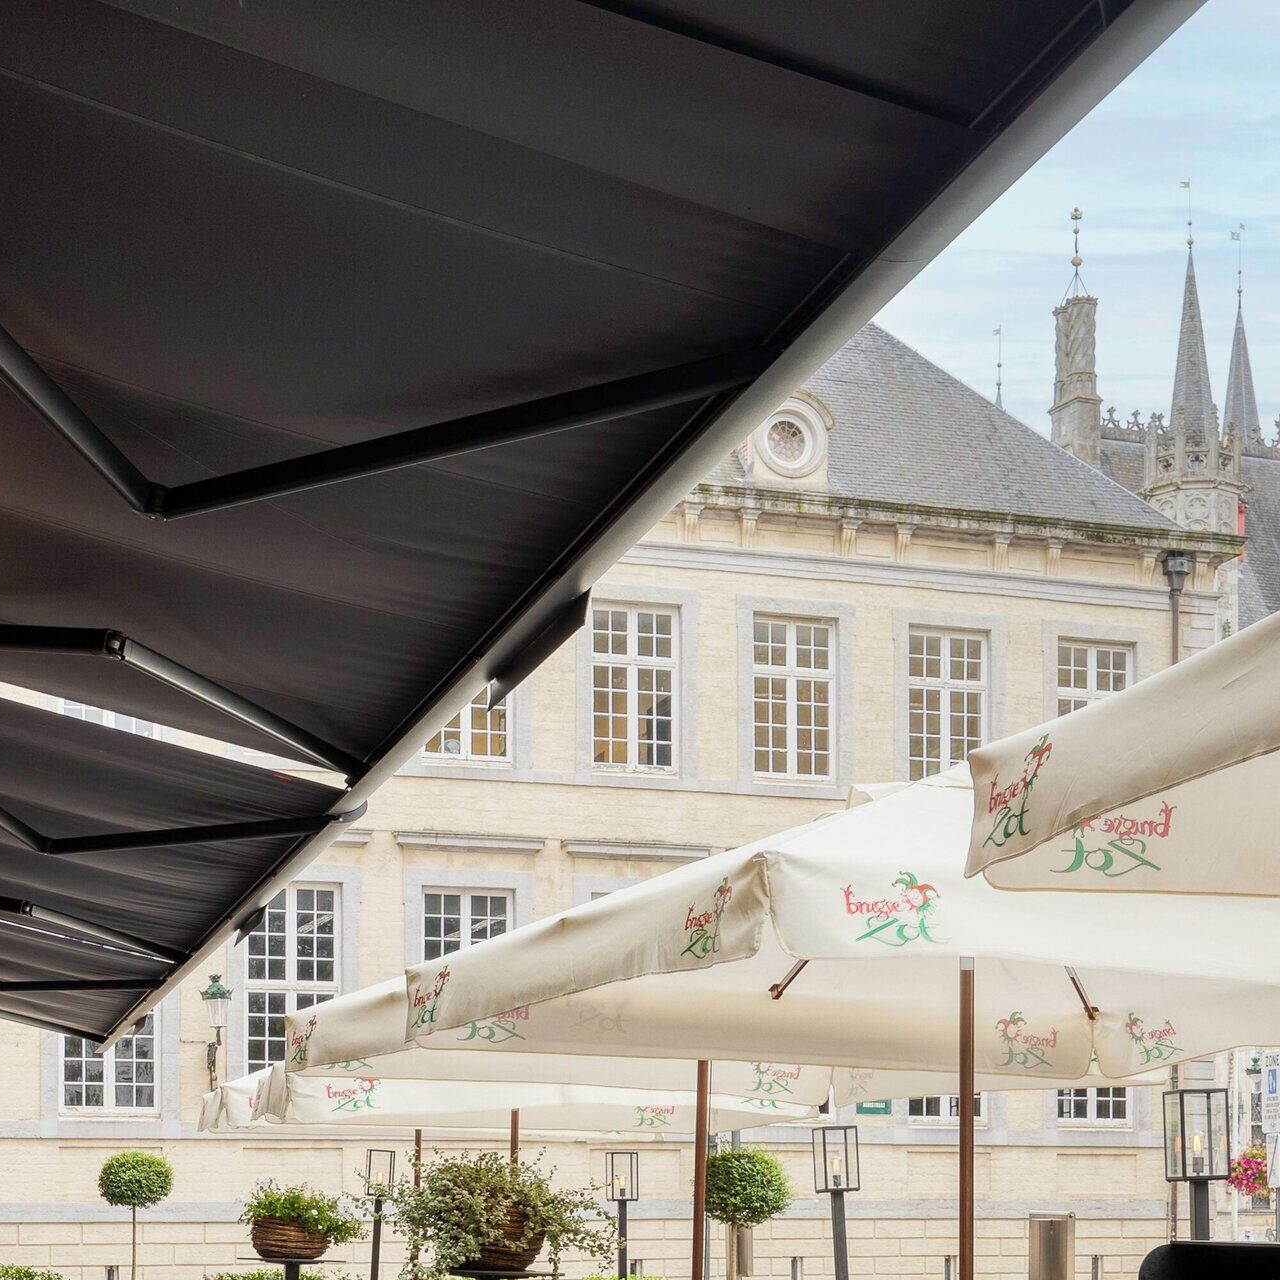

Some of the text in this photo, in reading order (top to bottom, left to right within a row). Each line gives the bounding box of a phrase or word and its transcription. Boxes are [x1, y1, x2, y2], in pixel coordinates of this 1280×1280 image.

[982, 799, 1032, 848] Zot
[840, 884, 903, 923] brugse
[855, 916, 952, 947] Zot
[1265, 1054, 1280, 1068] ZONE
